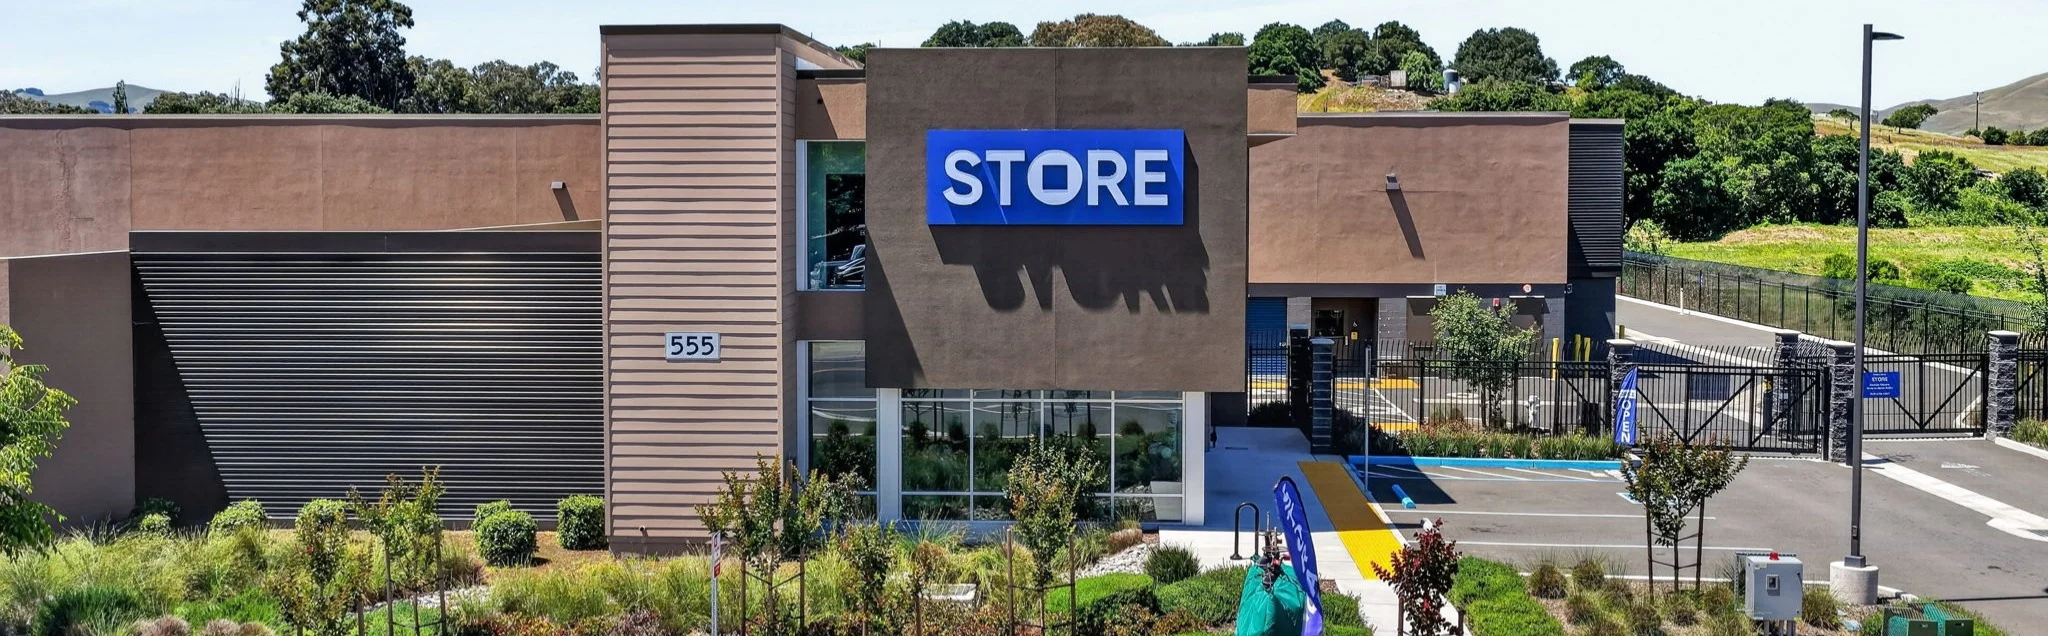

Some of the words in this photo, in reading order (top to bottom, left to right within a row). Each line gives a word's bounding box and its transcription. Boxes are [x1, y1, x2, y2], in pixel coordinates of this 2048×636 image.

[942, 149, 1169, 206] STORE
[671, 336, 714, 356] 555
[1621, 400, 1632, 443] OPEN
